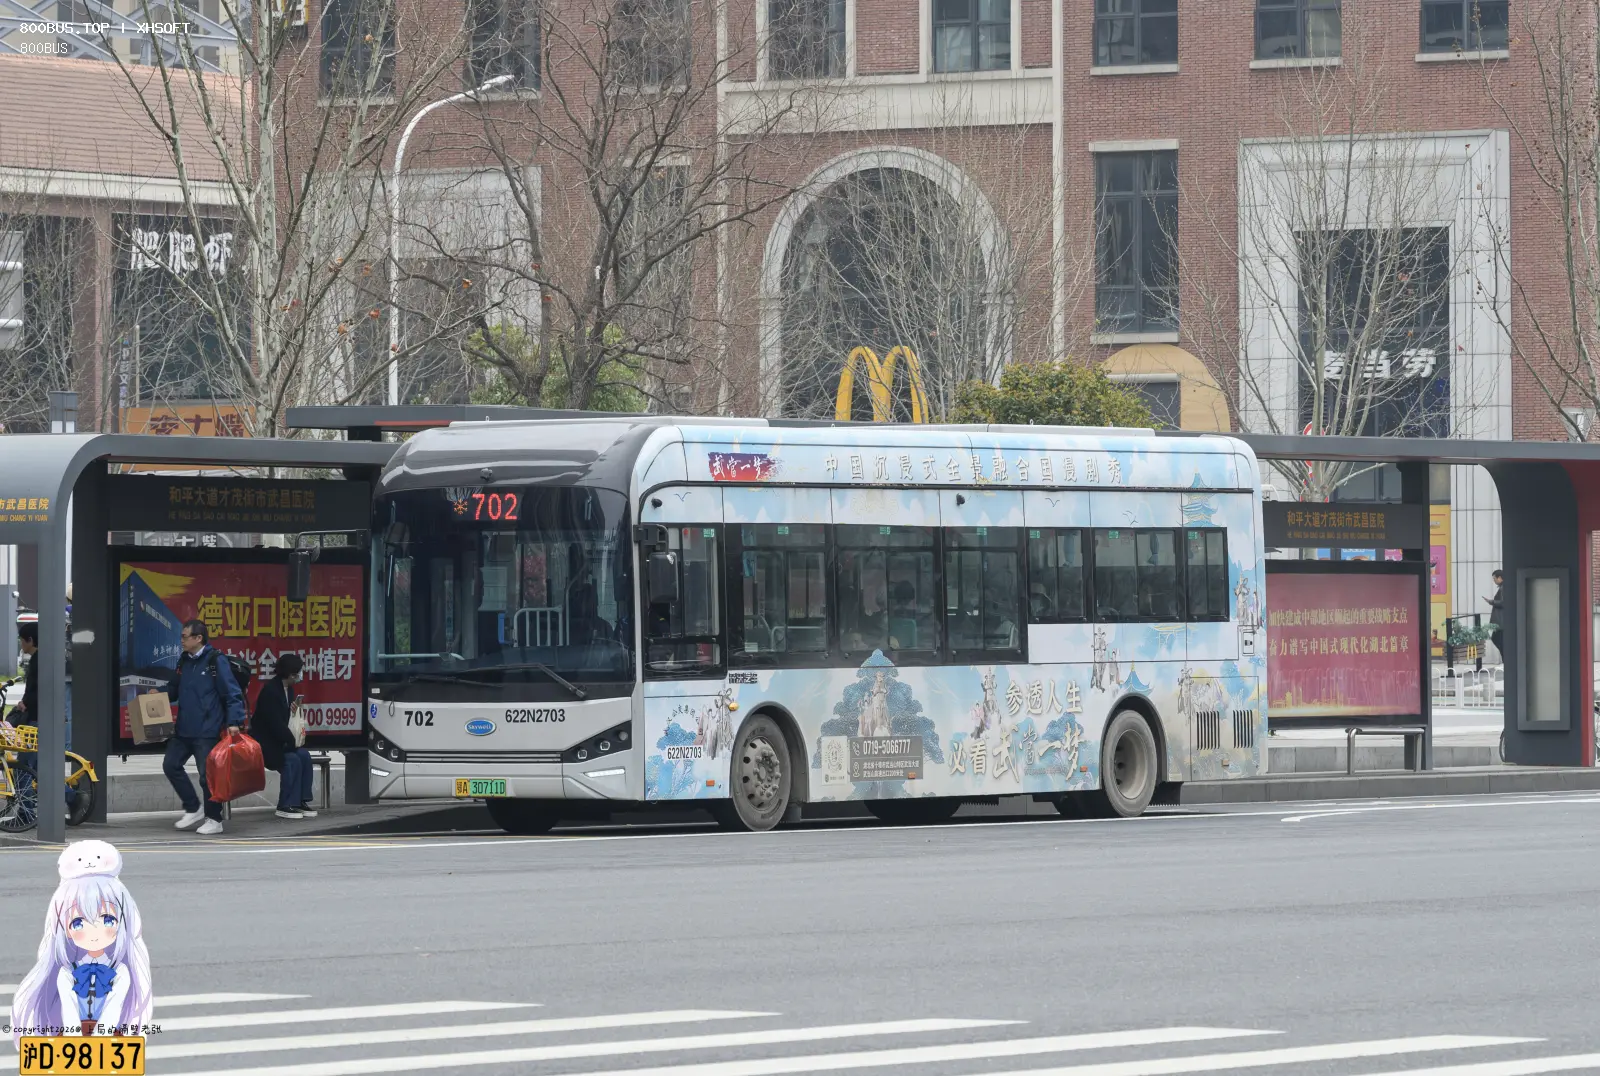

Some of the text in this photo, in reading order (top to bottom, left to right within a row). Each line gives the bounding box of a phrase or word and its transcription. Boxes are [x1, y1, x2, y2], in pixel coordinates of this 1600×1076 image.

[825, 454, 1122, 484] 中国沉浸式全景融合国漫剧秀
[169, 486, 315, 510] 和平大道才茂街市武昌医院
[472, 493, 518, 520] 702
[1287, 511, 1385, 529] 和平大道才茂街市武昌医院
[197, 594, 357, 638] 德亚口腔医院
[1005, 680, 1083, 717] 参透人生
[326, 708, 356, 726] 9999
[404, 710, 434, 727] 702
[505, 709, 566, 724] 622N2703
[667, 747, 702, 760] 622N2703
[863, 739, 911, 755] 0719-5066777
